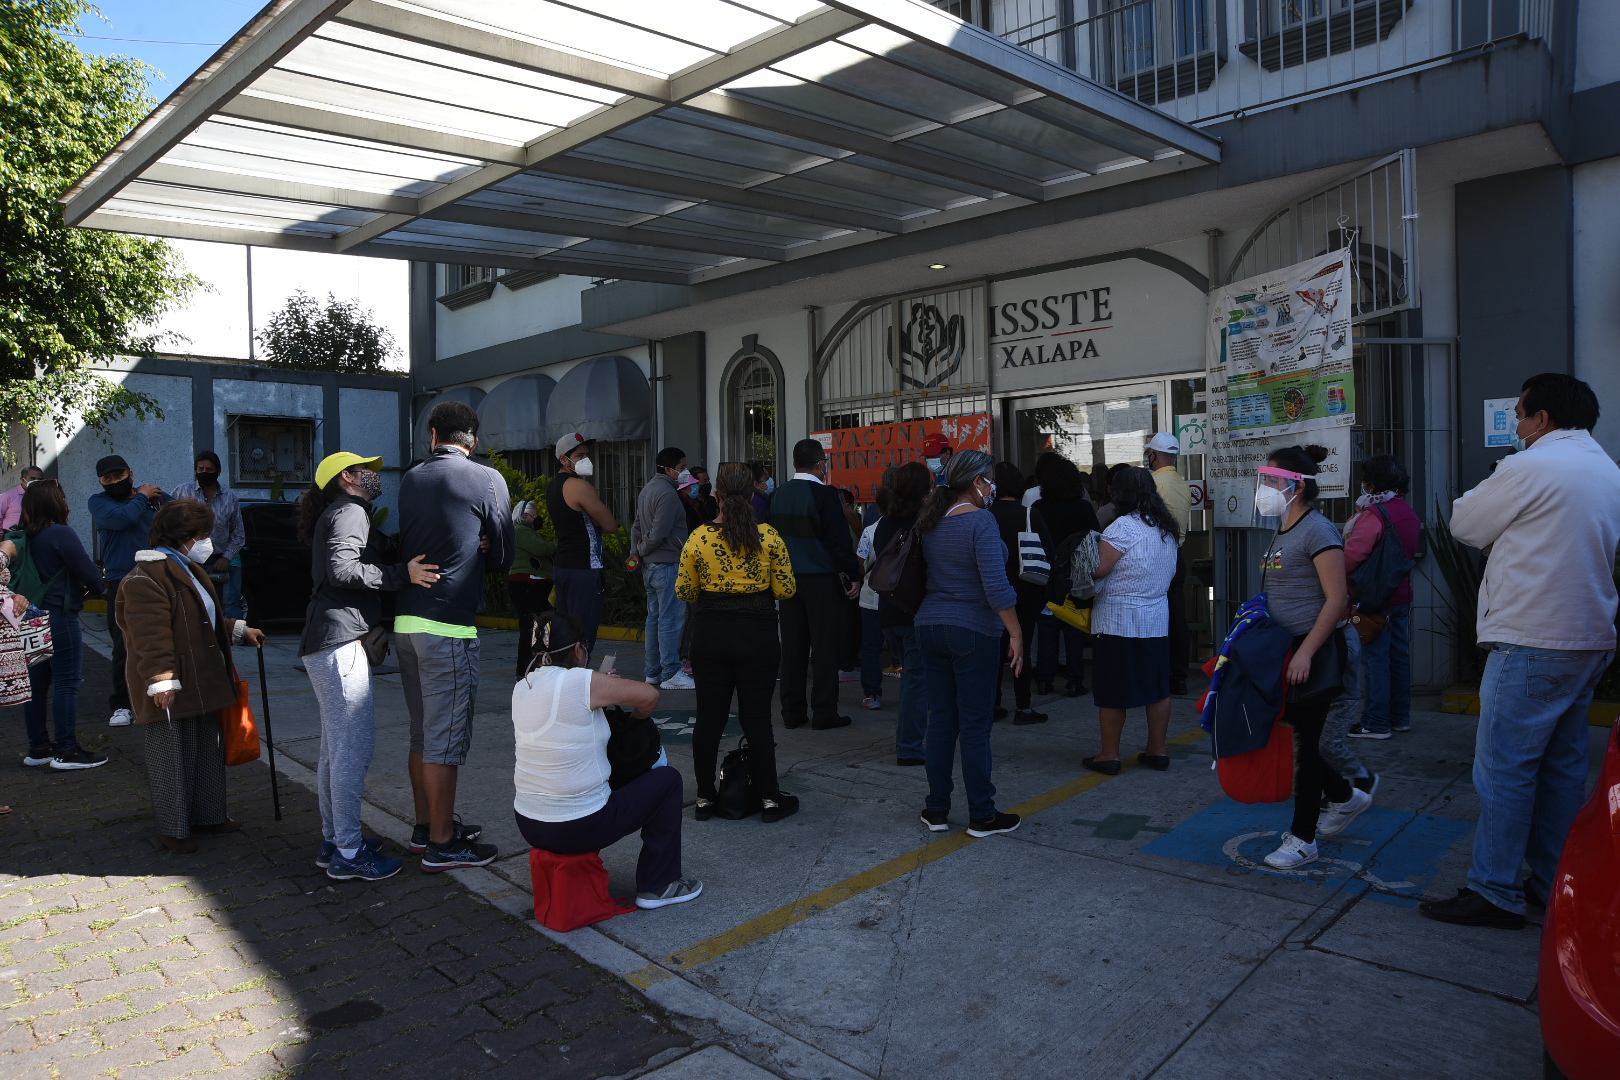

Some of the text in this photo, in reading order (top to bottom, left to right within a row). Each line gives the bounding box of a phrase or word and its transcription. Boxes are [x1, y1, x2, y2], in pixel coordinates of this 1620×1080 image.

[990, 287, 1113, 338] ISSSTE
[1001, 338, 1100, 370] XALAPA
[833, 424, 927, 449] VACUNA
